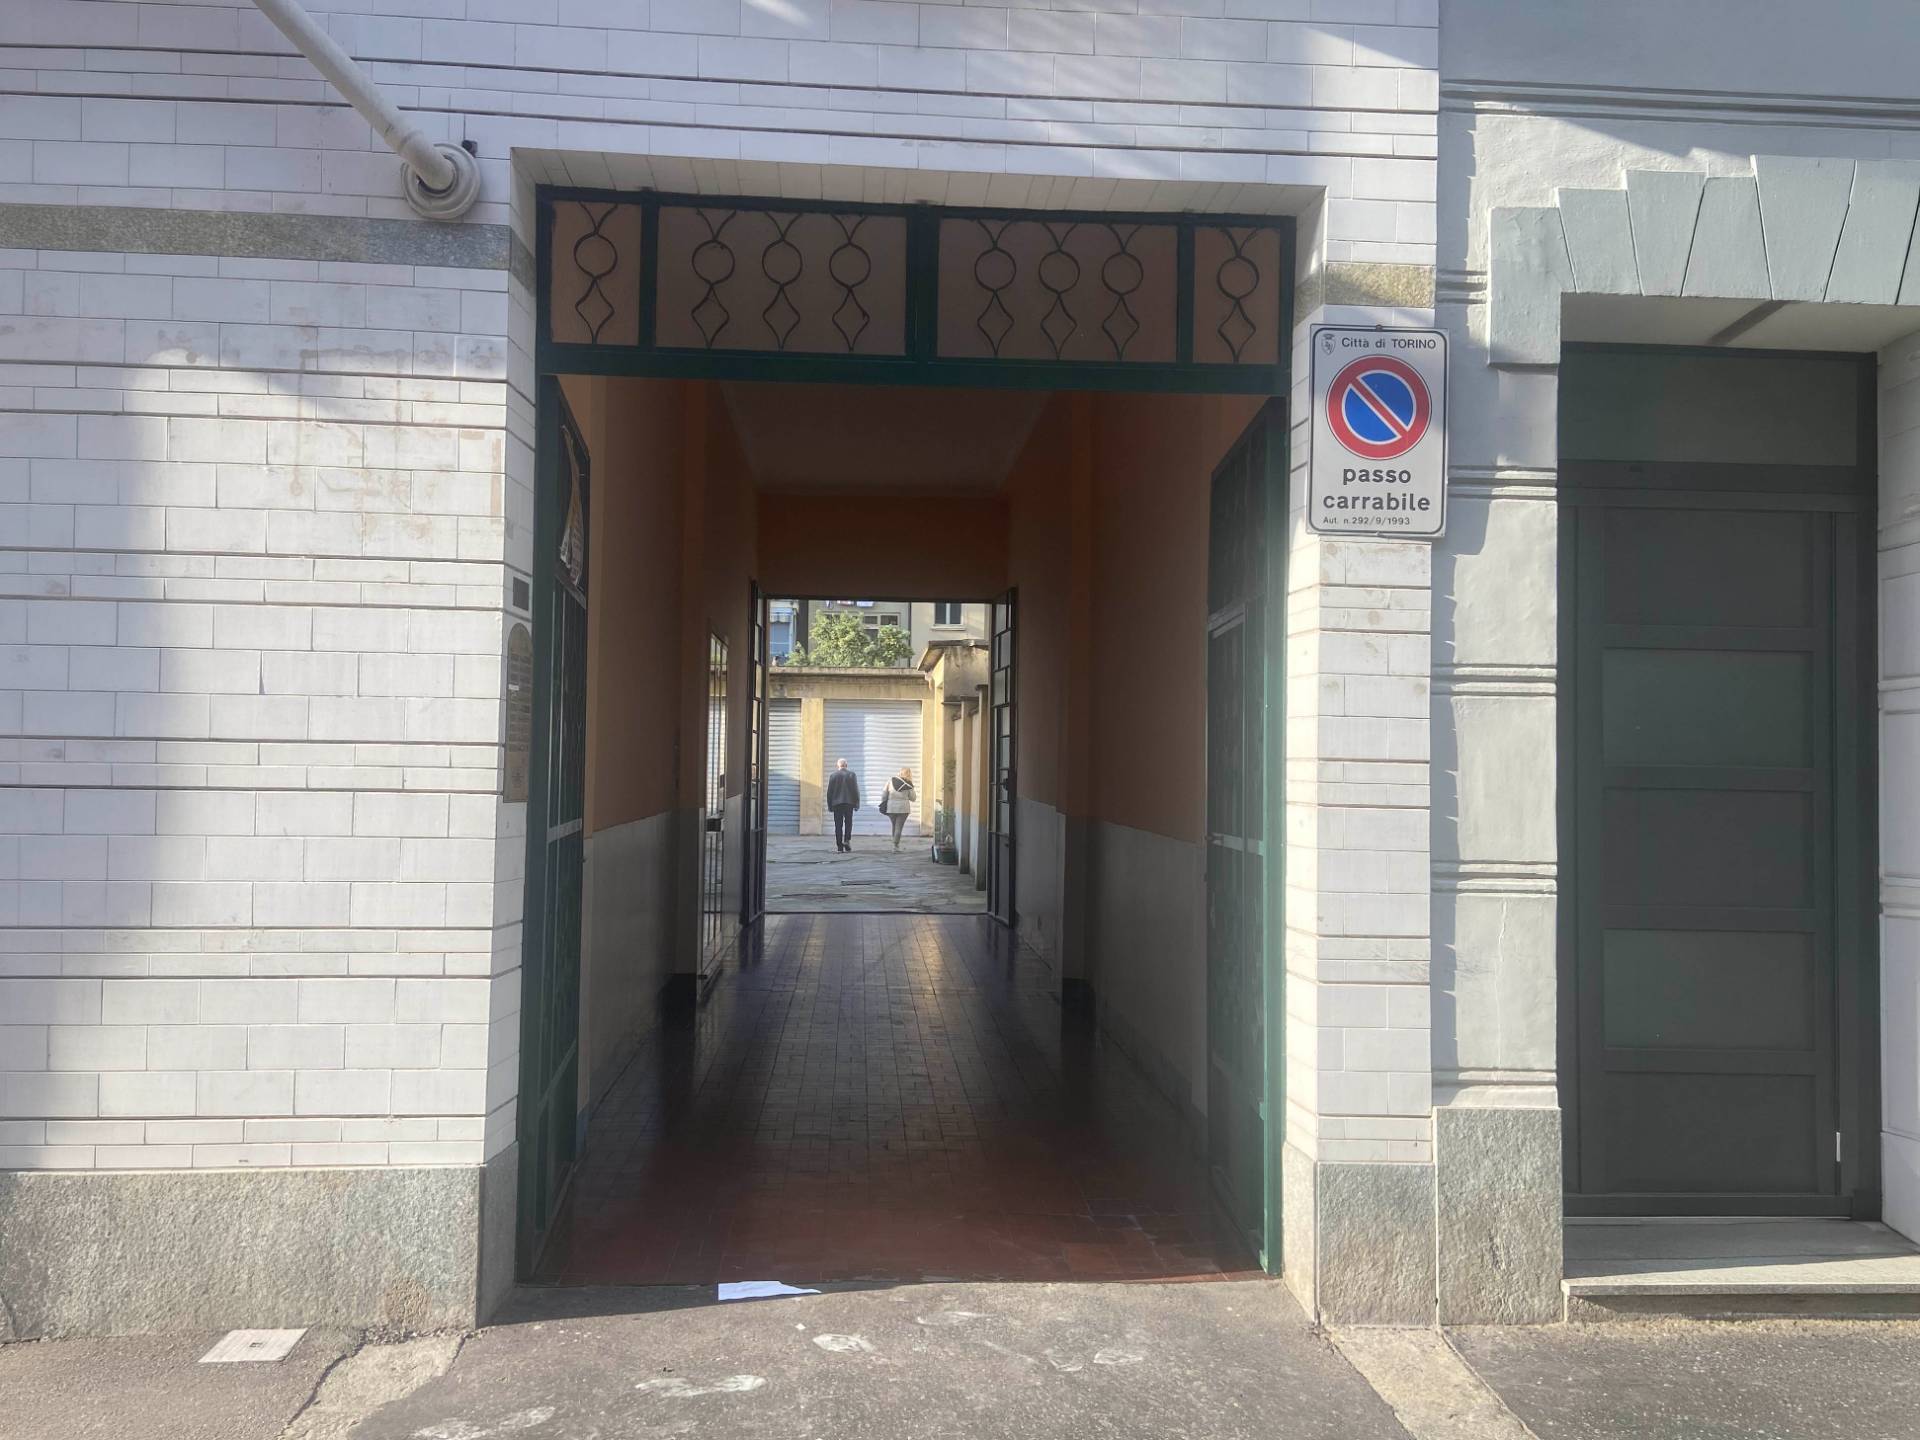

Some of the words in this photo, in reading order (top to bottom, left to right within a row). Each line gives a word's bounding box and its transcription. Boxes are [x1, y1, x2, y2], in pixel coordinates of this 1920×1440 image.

[1341, 337, 1370, 349] Città
[1375, 338, 1386, 349] di
[1391, 338, 1437, 350] TORINO
[1342, 468, 1412, 486] passo
[1323, 492, 1431, 511] carrabile
[1323, 516, 1338, 525] Aut.
